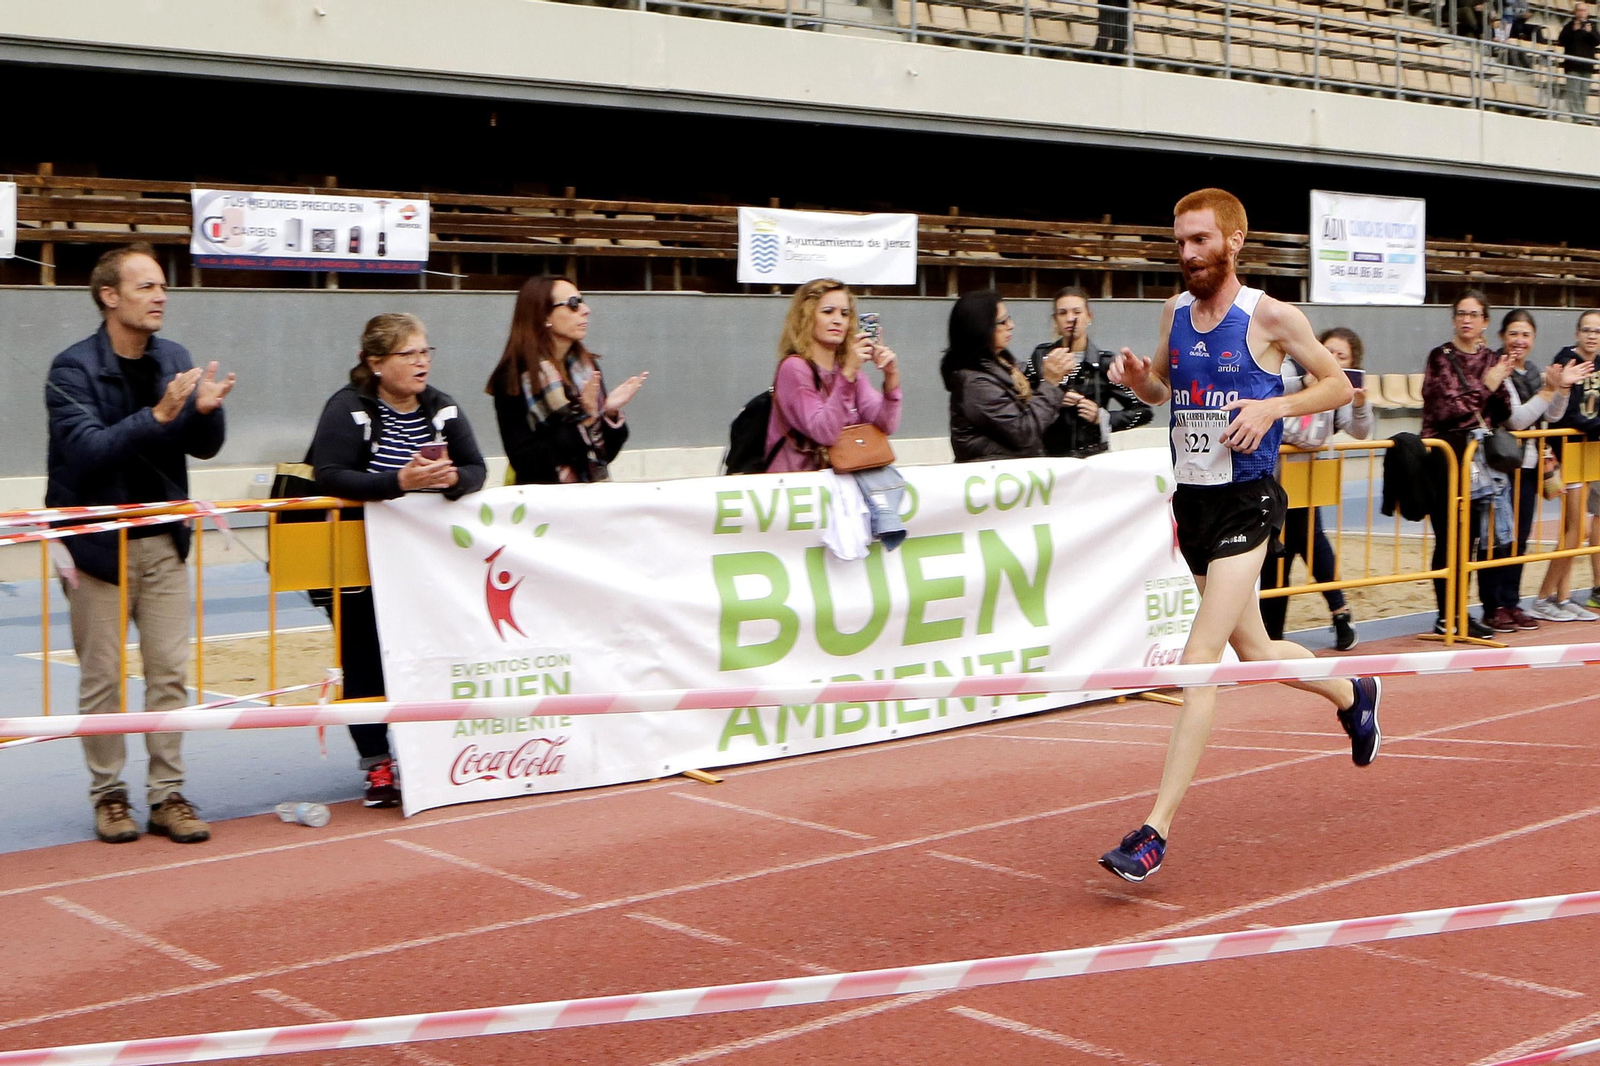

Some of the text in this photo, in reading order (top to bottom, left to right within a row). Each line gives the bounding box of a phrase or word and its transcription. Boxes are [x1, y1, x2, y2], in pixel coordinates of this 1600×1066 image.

[223, 196, 364, 213] TUS MEJORES PRECIOS EN
[231, 225, 277, 238] CARBIS
[785, 235, 912, 250] Ayuntamiento de Jerez
[1217, 364, 1240, 373] ardoi
[713, 468, 1056, 534] EVEO CON
[712, 523, 1055, 672] BUEN
[1146, 588, 1197, 621] BUE
[1147, 619, 1192, 639] AMBIE
[452, 654, 572, 677] EVENTOS CON
[453, 716, 573, 738] AMBIENTE
[450, 735, 570, 786] Coca-Cola
